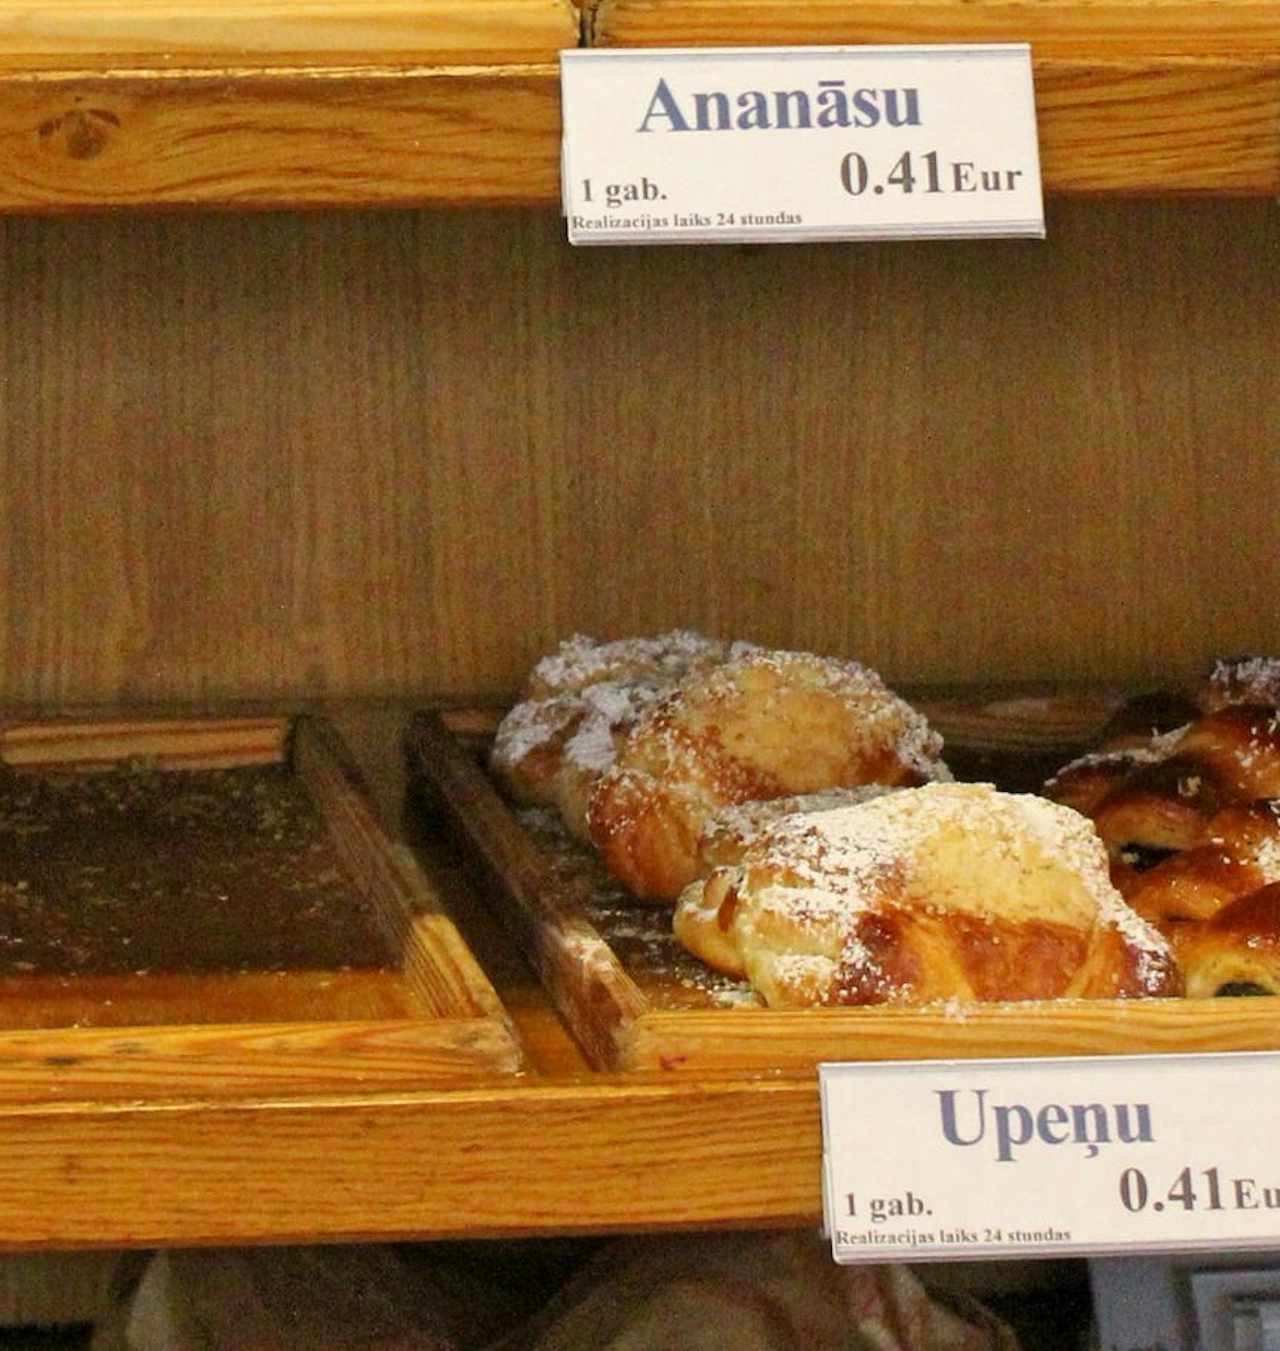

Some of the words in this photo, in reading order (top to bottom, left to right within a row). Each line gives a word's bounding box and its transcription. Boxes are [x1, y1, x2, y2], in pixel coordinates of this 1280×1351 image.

[636, 77, 922, 133] Ananāsu
[581, 179, 593, 202] 1
[605, 178, 668, 207] gab.
[572, 214, 669, 231] Realizacijas
[673, 213, 712, 228] laiks
[716, 212, 736, 227] 24
[740, 211, 802, 226] stundas
[934, 1088, 1156, 1163] Upeņu
[845, 1193, 857, 1217] 1
[870, 1192, 933, 1223] gab.
[836, 1230, 936, 1247] Realizacijas
[939, 1229, 979, 1244] laiks
[983, 1228, 1003, 1242] 24
[1008, 1228, 1071, 1242] stundas
